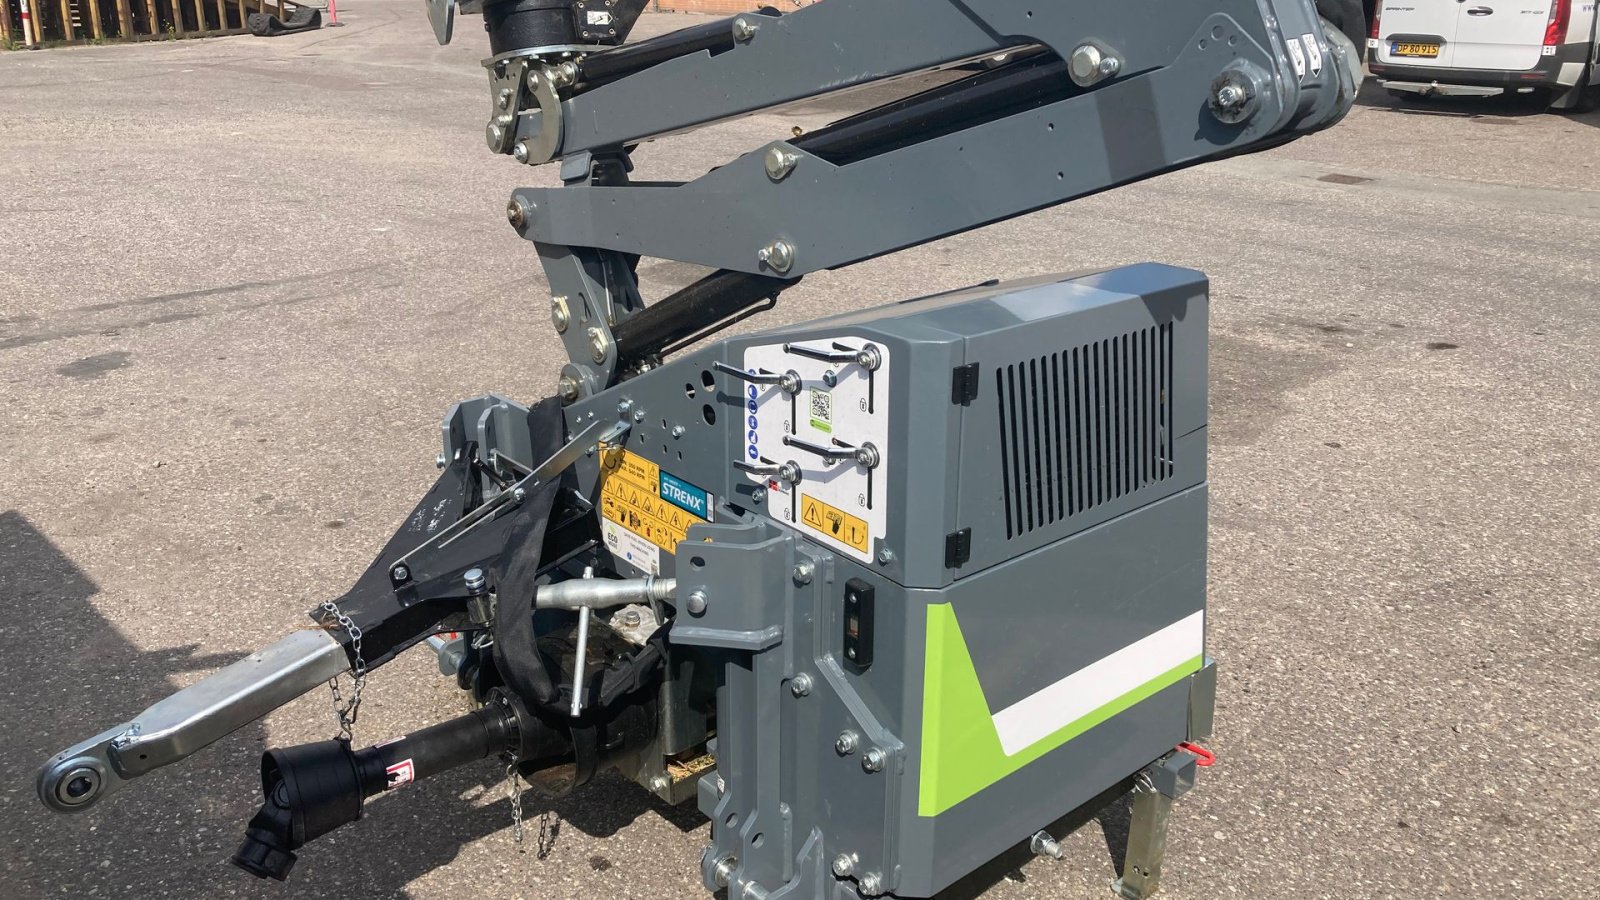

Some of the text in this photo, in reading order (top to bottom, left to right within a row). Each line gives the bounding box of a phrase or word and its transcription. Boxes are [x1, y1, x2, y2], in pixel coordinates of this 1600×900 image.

[1397, 44, 1437, 54] DP 80 915
[607, 532, 618, 544] ECO
